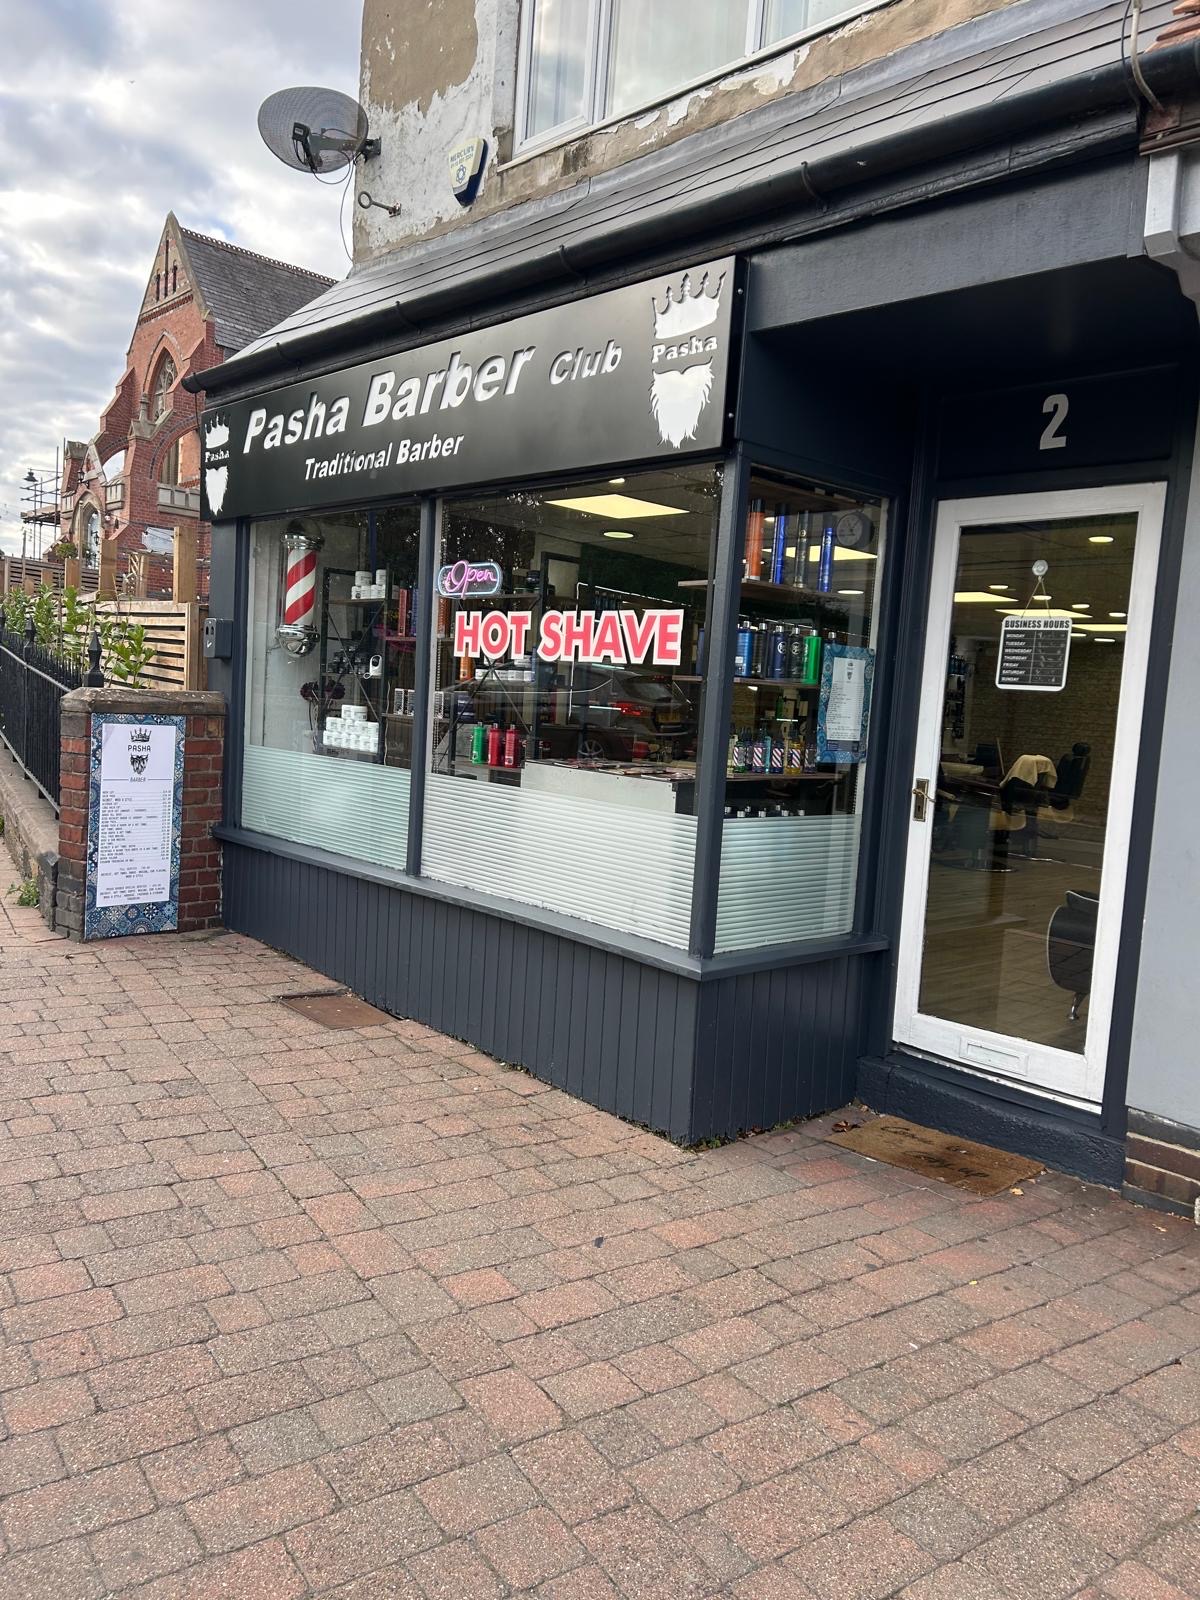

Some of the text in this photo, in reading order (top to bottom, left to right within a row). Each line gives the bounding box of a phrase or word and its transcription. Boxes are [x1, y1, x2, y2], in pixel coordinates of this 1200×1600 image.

[650, 334, 718, 364] Pasha
[243, 340, 622, 454] Pasha Barber Club
[1039, 393, 1070, 450] 2
[204, 448, 230, 463] Pasha
[304, 433, 464, 481] Traditional Barber
[445, 560, 498, 600] Open
[453, 609, 684, 666] HOT SHAVE
[1004, 620, 1070, 629] BUSINESS HOURS
[127, 744, 151, 752] PASHA
